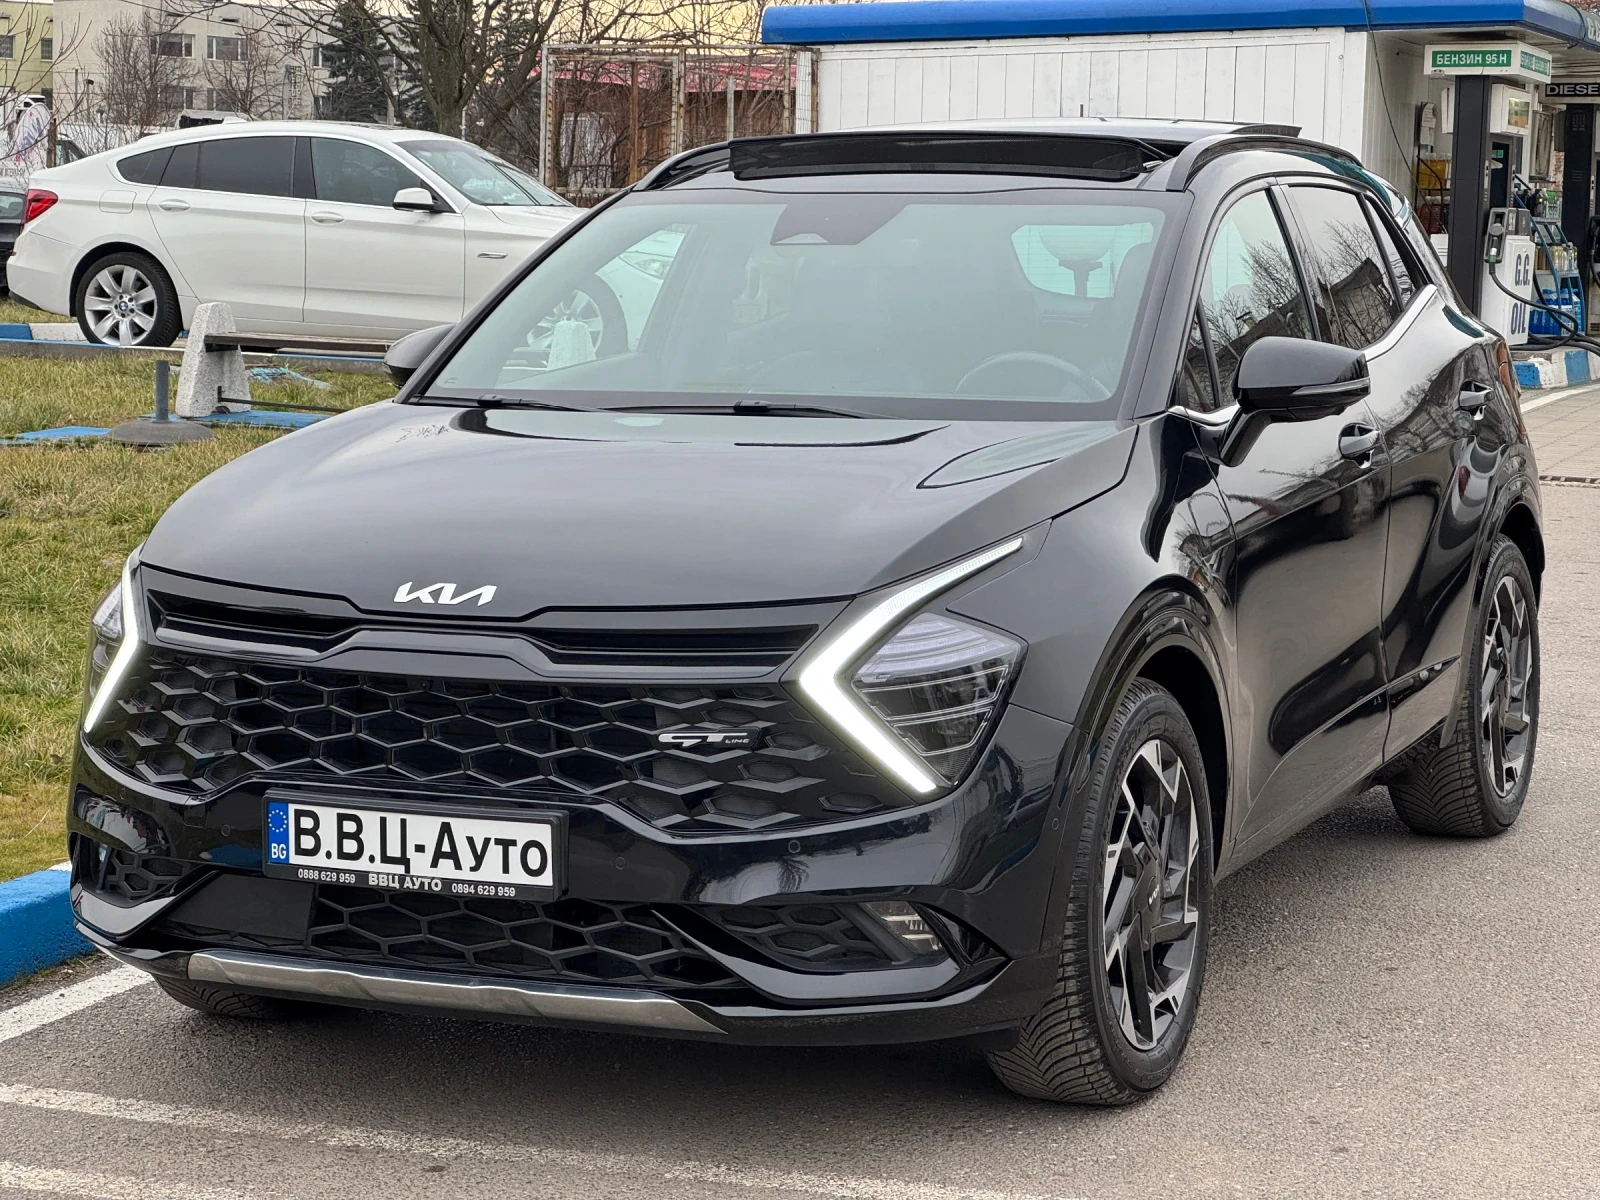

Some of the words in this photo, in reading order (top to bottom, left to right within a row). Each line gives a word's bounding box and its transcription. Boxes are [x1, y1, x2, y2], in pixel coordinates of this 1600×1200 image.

[1436, 53, 1482, 65] БЕНЗИН
[1514, 253, 1531, 287] G.G.
[1510, 302, 1527, 335] OIL
[393, 581, 498, 607] KIA
[271, 843, 287, 860] BG
[297, 868, 320, 880] 0888
[320, 871, 337, 882] 629
[338, 873, 356, 884] 959
[368, 873, 400, 889] ВВЦ
[403, 876, 442, 891] АУТО
[451, 883, 475, 894] 0894
[477, 885, 496, 896] 629
[497, 886, 516, 897] 959
